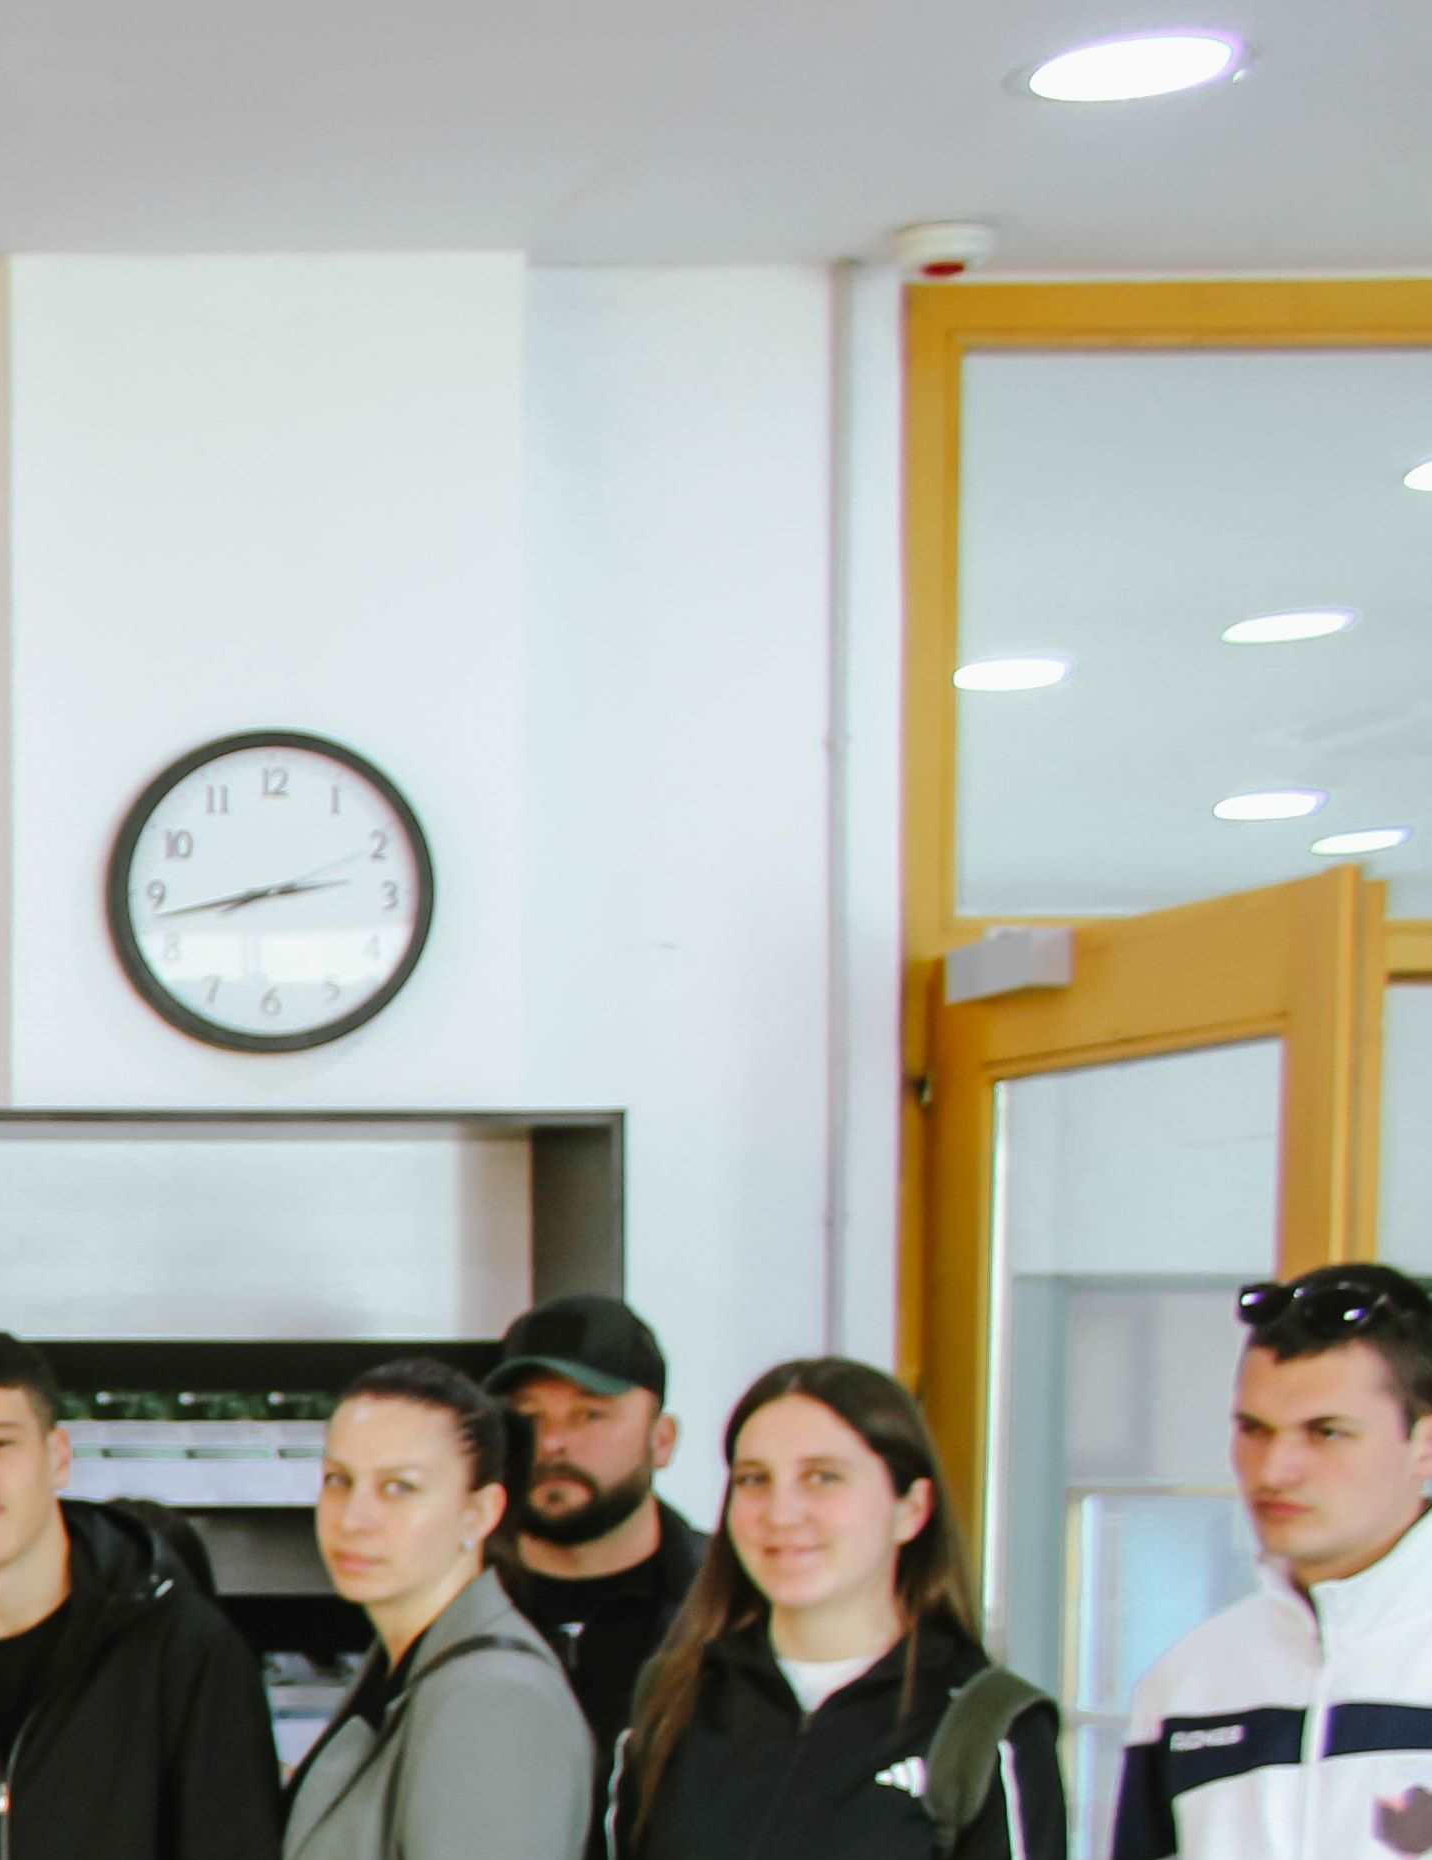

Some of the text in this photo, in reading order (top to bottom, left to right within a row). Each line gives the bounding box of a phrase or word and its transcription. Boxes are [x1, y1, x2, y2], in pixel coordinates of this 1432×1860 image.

[261, 767, 290, 797] 12
[206, 784, 230, 815] 11
[330, 785, 340, 816] 1
[164, 829, 195, 860] 10
[369, 829, 389, 861] 2
[146, 880, 167, 910] 9
[381, 880, 399, 911] 3
[202, 975, 222, 1004] 7
[260, 985, 283, 1017] 6
